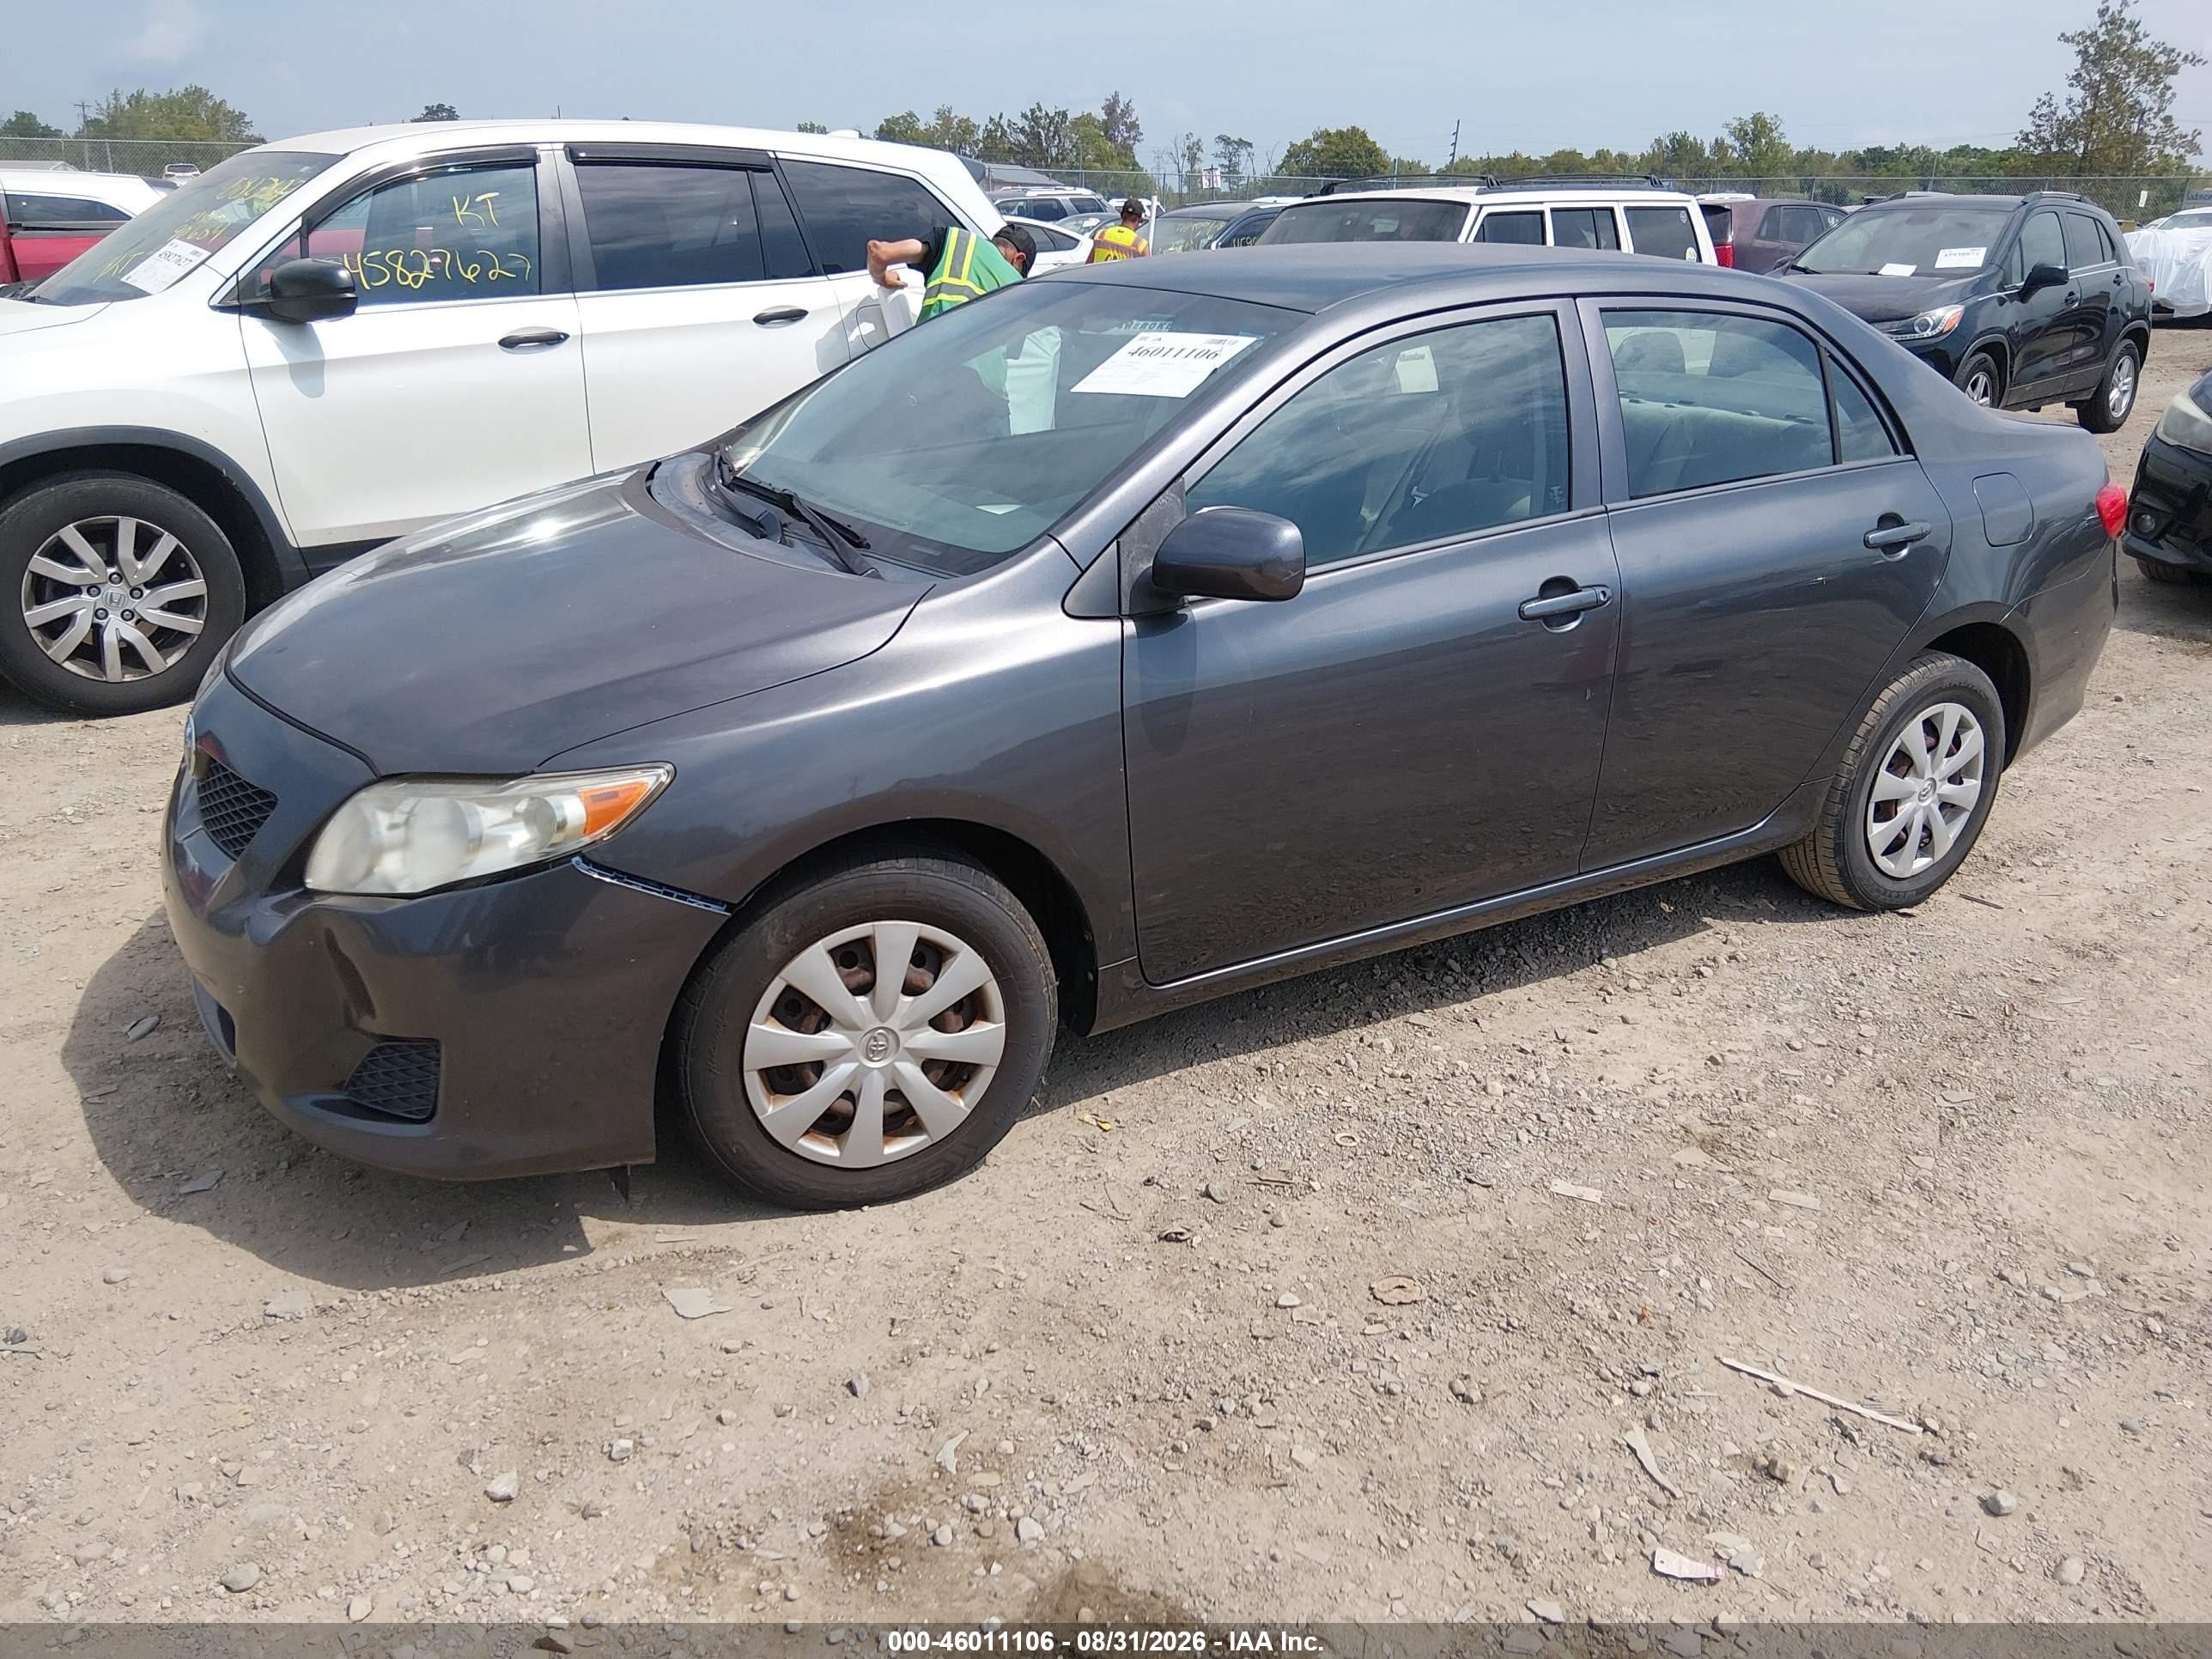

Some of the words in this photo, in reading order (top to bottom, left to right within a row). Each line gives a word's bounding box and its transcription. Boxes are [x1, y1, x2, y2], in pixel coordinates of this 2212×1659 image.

[453, 191, 501, 228] KT
[343, 248, 532, 289] 45827627
[1127, 345, 1219, 361] 46011106
